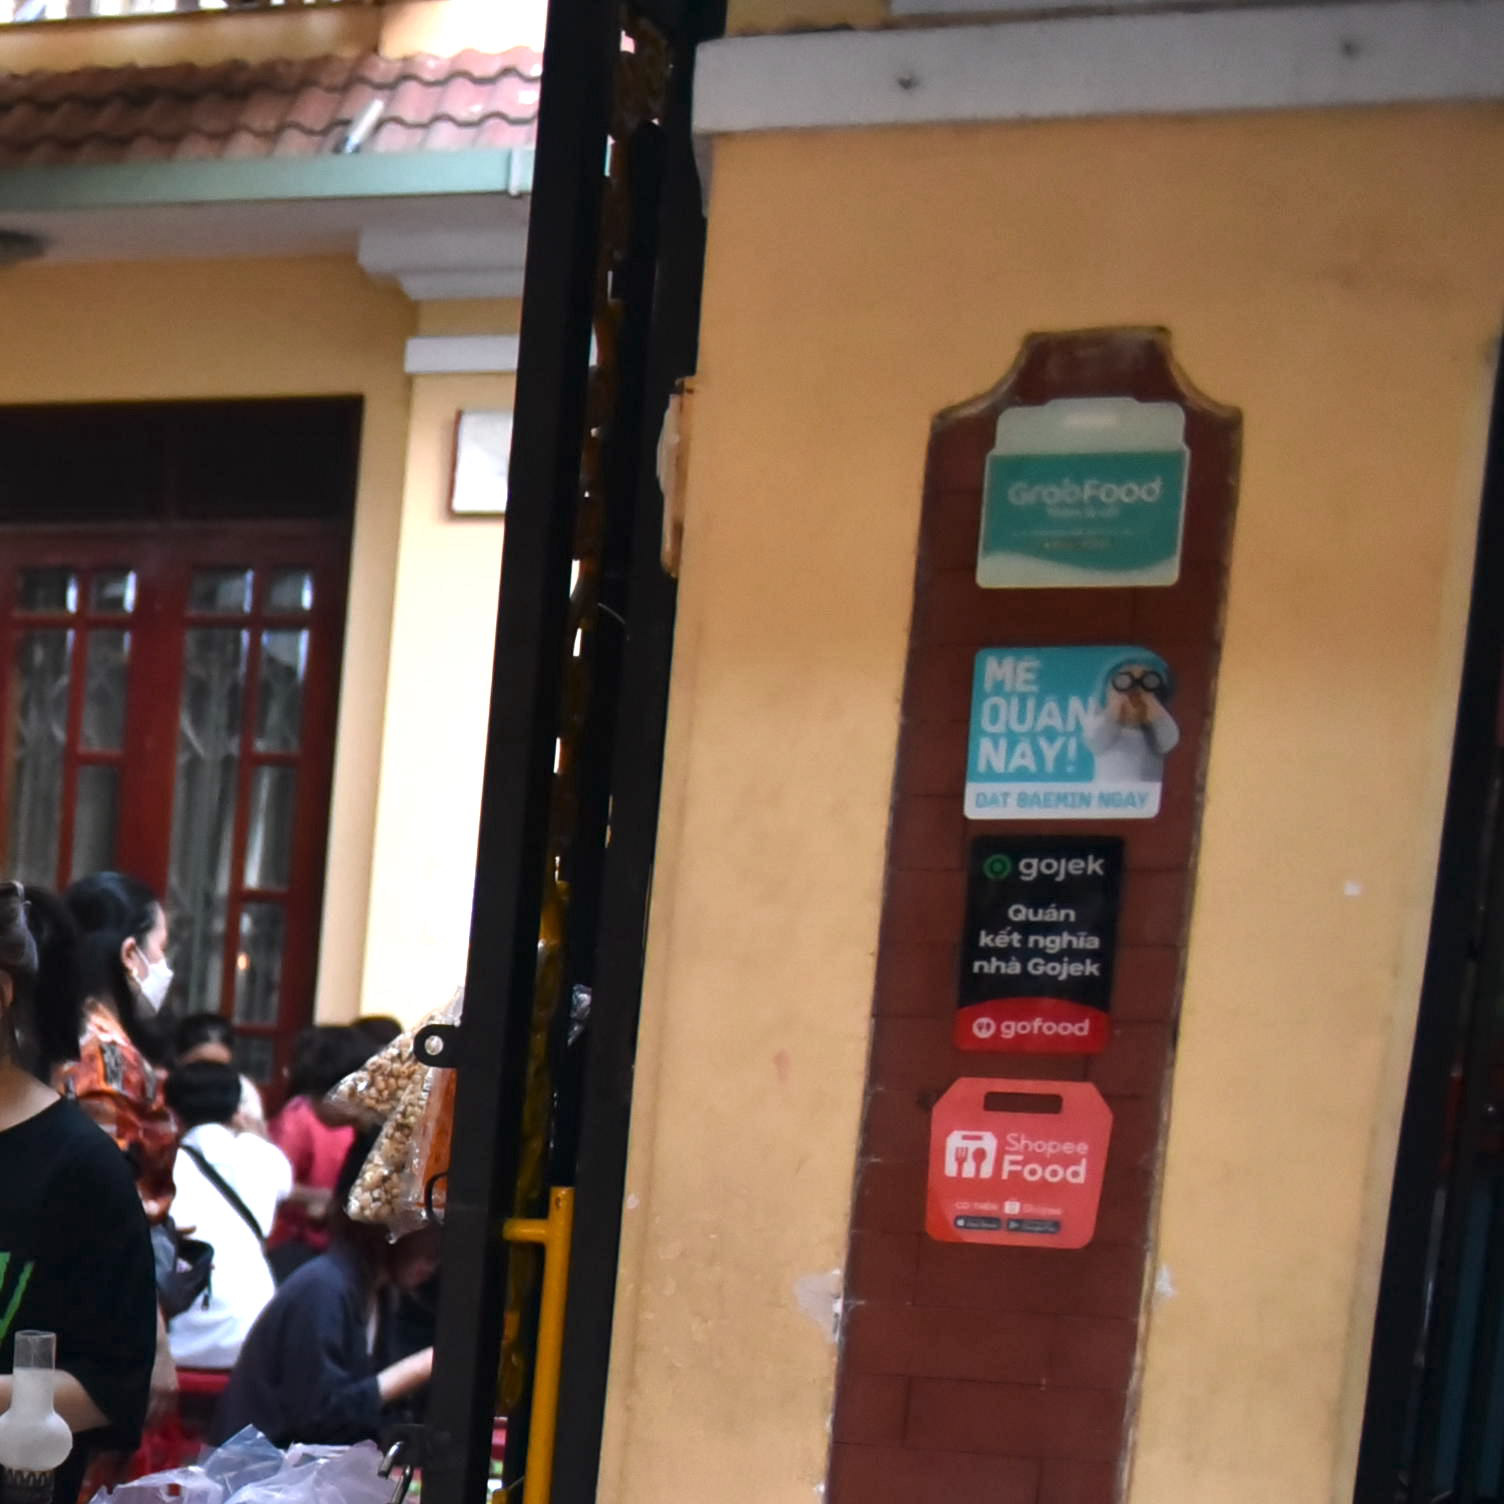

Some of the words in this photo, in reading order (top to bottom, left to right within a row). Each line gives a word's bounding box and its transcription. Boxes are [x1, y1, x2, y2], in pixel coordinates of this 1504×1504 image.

[1008, 475, 1163, 506] GrabFood
[1018, 855, 1105, 882] gojek
[1007, 904, 1076, 922] Quán
[978, 926, 1023, 949] kết
[1027, 931, 1100, 954] nghĩa
[972, 955, 1022, 975] nhà
[1027, 957, 1101, 981] Gojek
[1000, 1017, 1091, 1039] gofood
[1005, 1132, 1089, 1158] Shopee
[1001, 1154, 1087, 1184] Food
